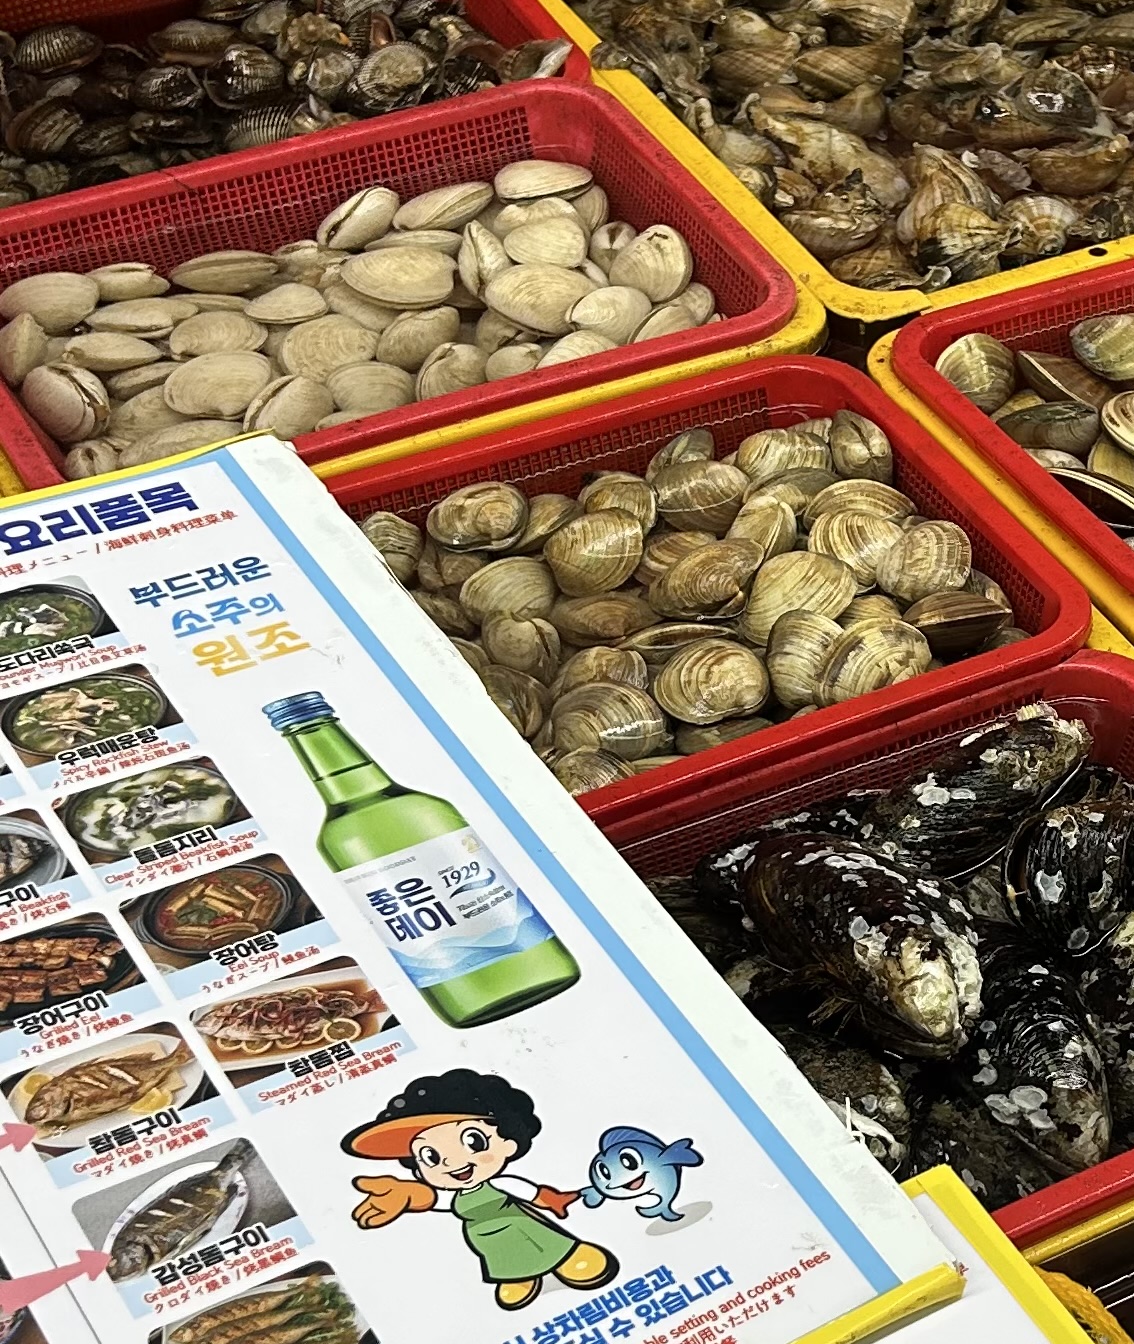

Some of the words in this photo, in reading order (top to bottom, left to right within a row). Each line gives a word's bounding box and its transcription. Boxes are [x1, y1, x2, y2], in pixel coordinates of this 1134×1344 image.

[129, 556, 272, 608] 부드러운
[172, 592, 286, 639] 소주의
[90, 644, 117, 658] Soup
[191, 620, 312, 677] 원조
[57, 727, 158, 766] 우럭매운탕
[61, 762, 91, 777] Spicy
[92, 749, 138, 766] Rockfish
[141, 739, 169, 753] Stew
[104, 870, 135, 885] Clear
[137, 855, 180, 876] Striped
[181, 838, 229, 860] Beakfish
[231, 829, 259, 845] Soup
[441, 860, 481, 889] 1929
[365, 877, 437, 917] 좋은
[384, 900, 457, 943] 데이
[213, 932, 279, 967] 장어탕
[228, 958, 248, 973] Eel
[249, 949, 280, 967] Soup
[16, 992, 109, 1036] 장어구이
[40, 1018, 79, 1040] Grilled
[81, 1011, 102, 1027] Eel
[258, 1075, 311, 1101] Steamed
[313, 1066, 338, 1084] Red
[338, 1057, 362, 1075] Sea
[363, 1041, 402, 1063] Bream
[73, 1152, 115, 1174] Grilled
[117, 1142, 141, 1159] Red
[144, 1130, 167, 1146] Sea
[169, 1115, 211, 1137] Bream
[89, 1108, 182, 1155] 참돔구이
[143, 1280, 186, 1304] Grilled
[187, 1265, 225, 1286] Black
[224, 1255, 250, 1270] Sea
[250, 1236, 294, 1258] Bream
[151, 1225, 270, 1286] 감성돔구이
[608, 1316, 636, 1339] 수
[634, 1264, 734, 1327] 있습니다
[669, 1309, 719, 1339] setting
[718, 1291, 747, 1315] and
[747, 1263, 802, 1300] cooking
[799, 1250, 832, 1272] fees
